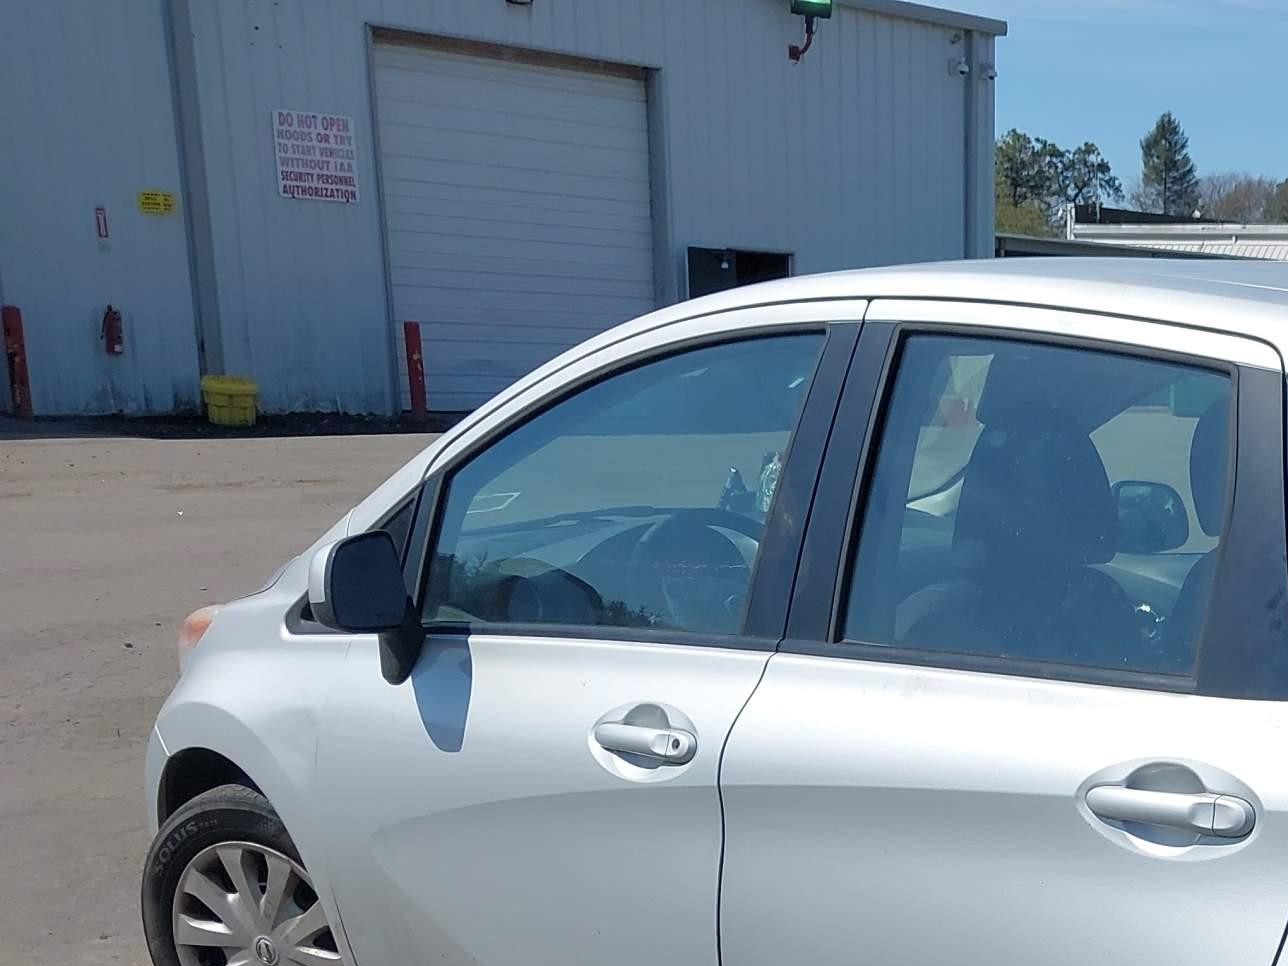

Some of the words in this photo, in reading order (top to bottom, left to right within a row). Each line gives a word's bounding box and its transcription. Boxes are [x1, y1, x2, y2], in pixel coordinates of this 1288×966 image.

[279, 111, 293, 127] DO
[297, 113, 317, 129] NOT
[322, 116, 349, 132] OPEN
[277, 128, 313, 142] HOODS
[316, 132, 330, 144] OR
[334, 134, 352, 146] TRY
[278, 142, 288, 154] TO
[291, 144, 316, 157] START
[319, 147, 354, 160] VEHICLES
[279, 156, 331, 170] WITHOUT
[335, 161, 353, 173] IAA
[281, 170, 314, 184] SECURITY
[317, 173, 356, 187] PERSONNEL
[282, 184, 357, 200] AUTHORIZATION
